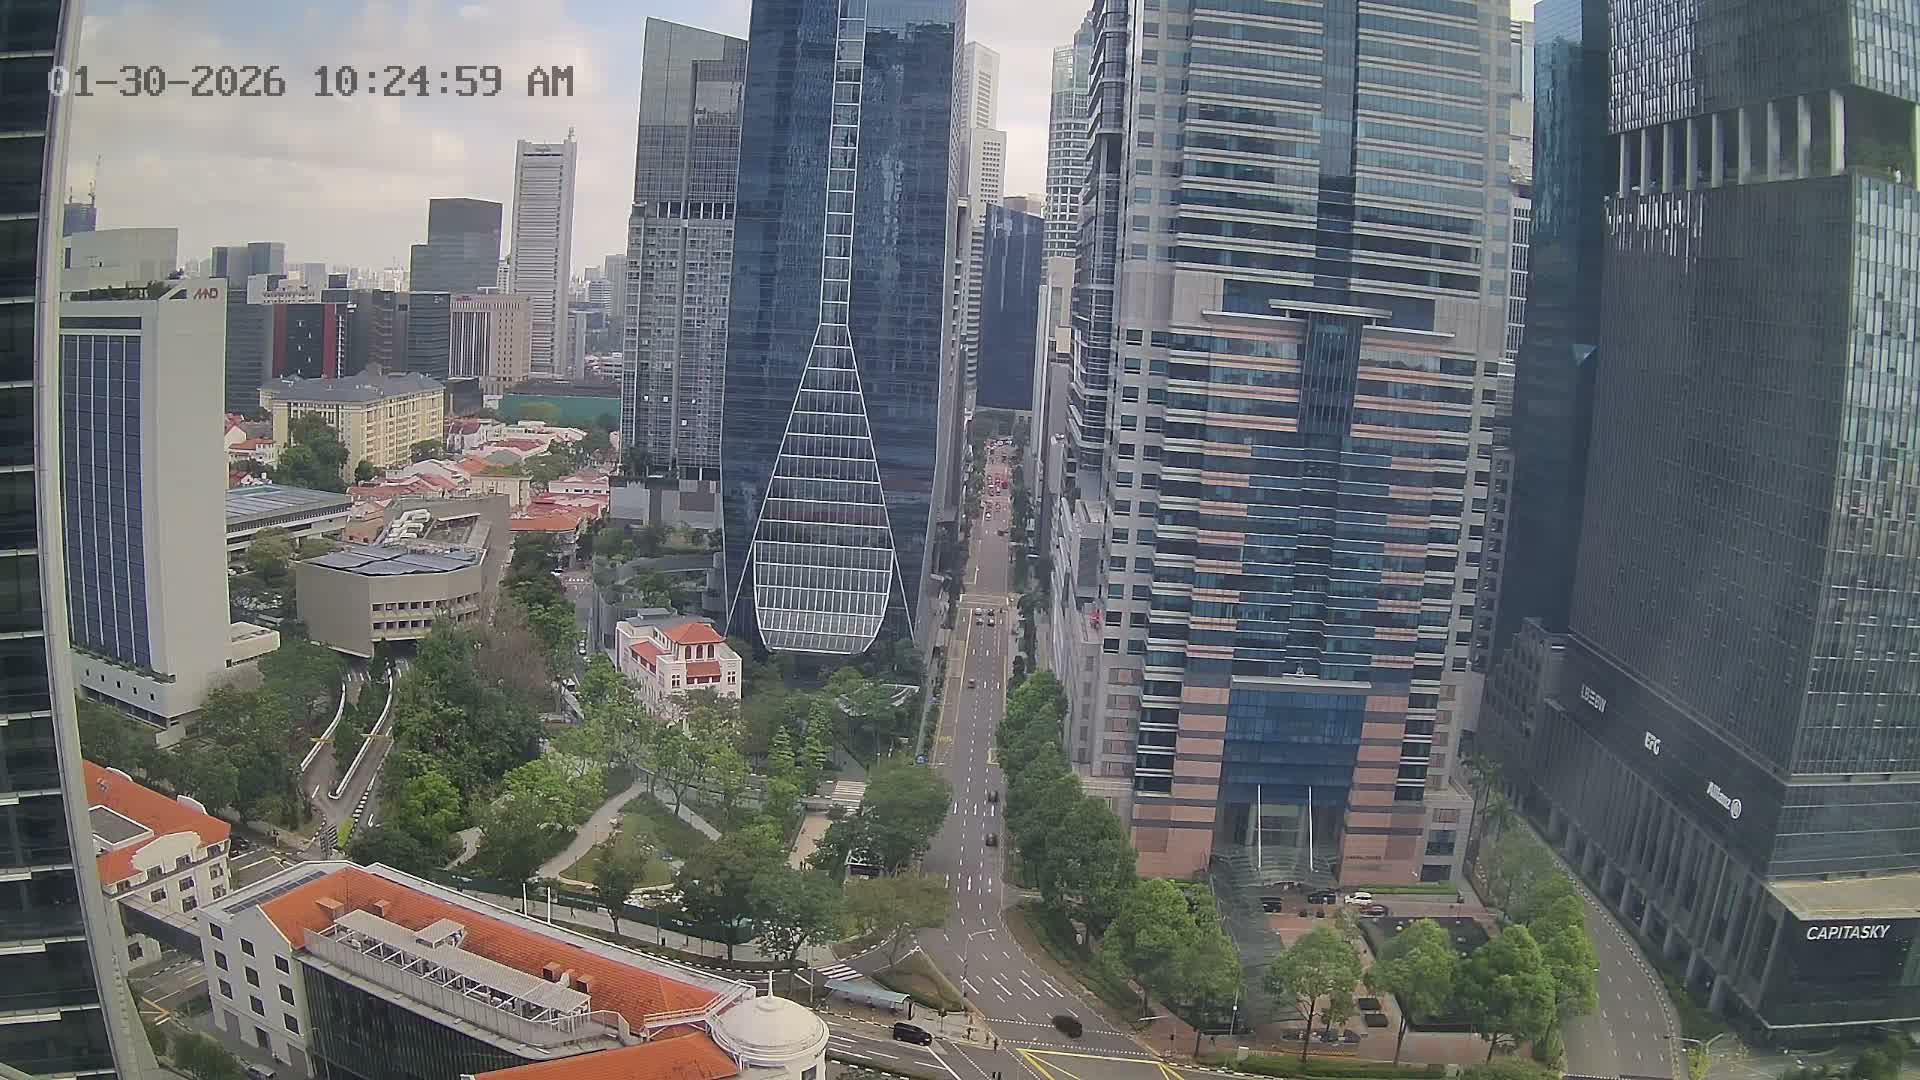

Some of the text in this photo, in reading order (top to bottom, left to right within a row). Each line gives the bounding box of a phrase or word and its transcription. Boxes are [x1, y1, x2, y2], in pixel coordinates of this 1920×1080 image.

[1645, 731, 1662, 755] EFG
[1706, 781, 1732, 810] Allianz
[1807, 925, 1890, 939] CAPITASKY
